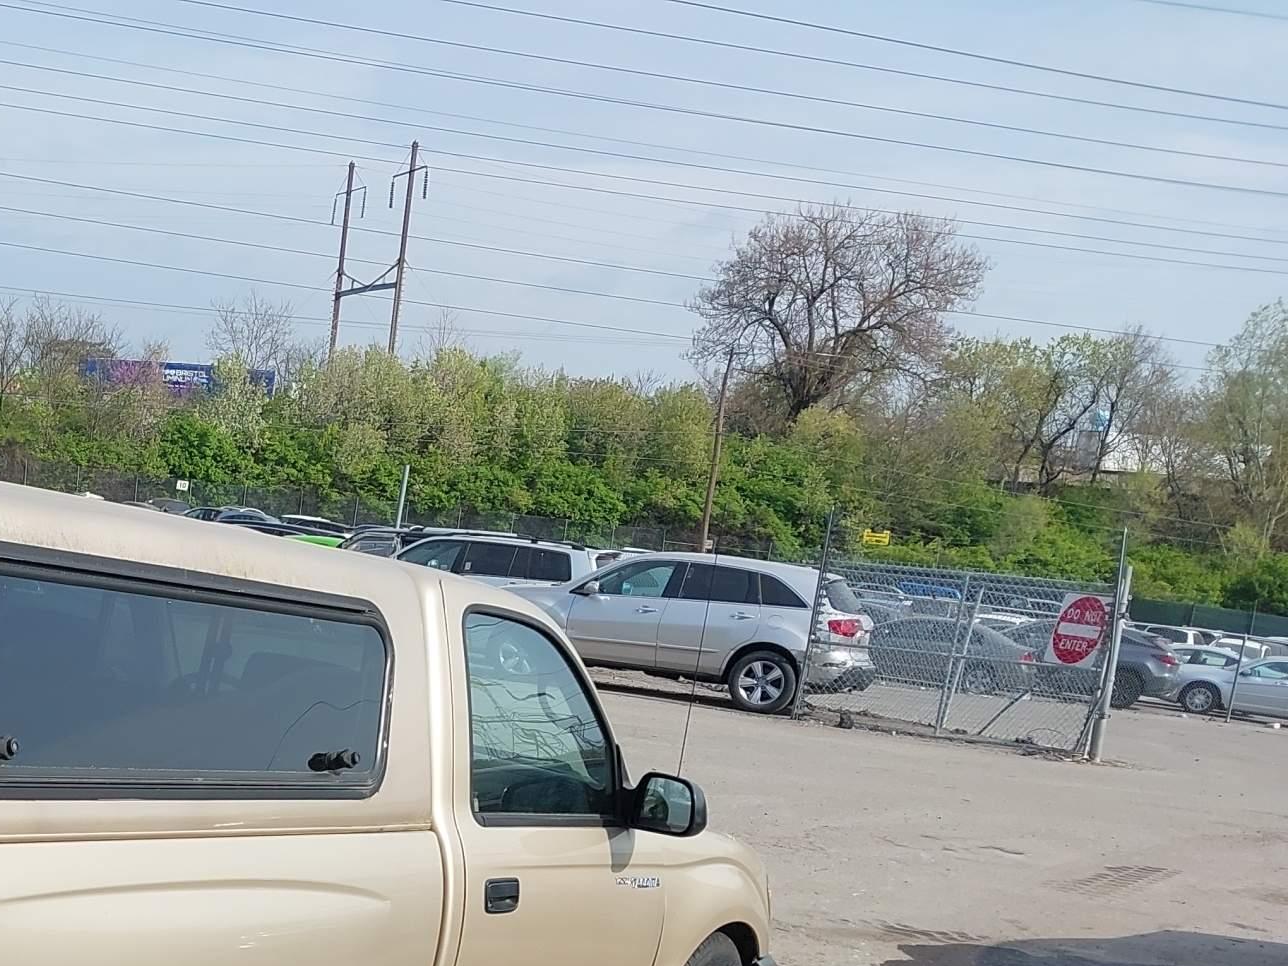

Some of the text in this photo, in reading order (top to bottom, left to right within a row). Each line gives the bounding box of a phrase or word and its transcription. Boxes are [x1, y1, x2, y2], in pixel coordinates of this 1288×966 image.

[1066, 608, 1102, 623] DO NOT
[1059, 638, 1088, 653] ENTER
